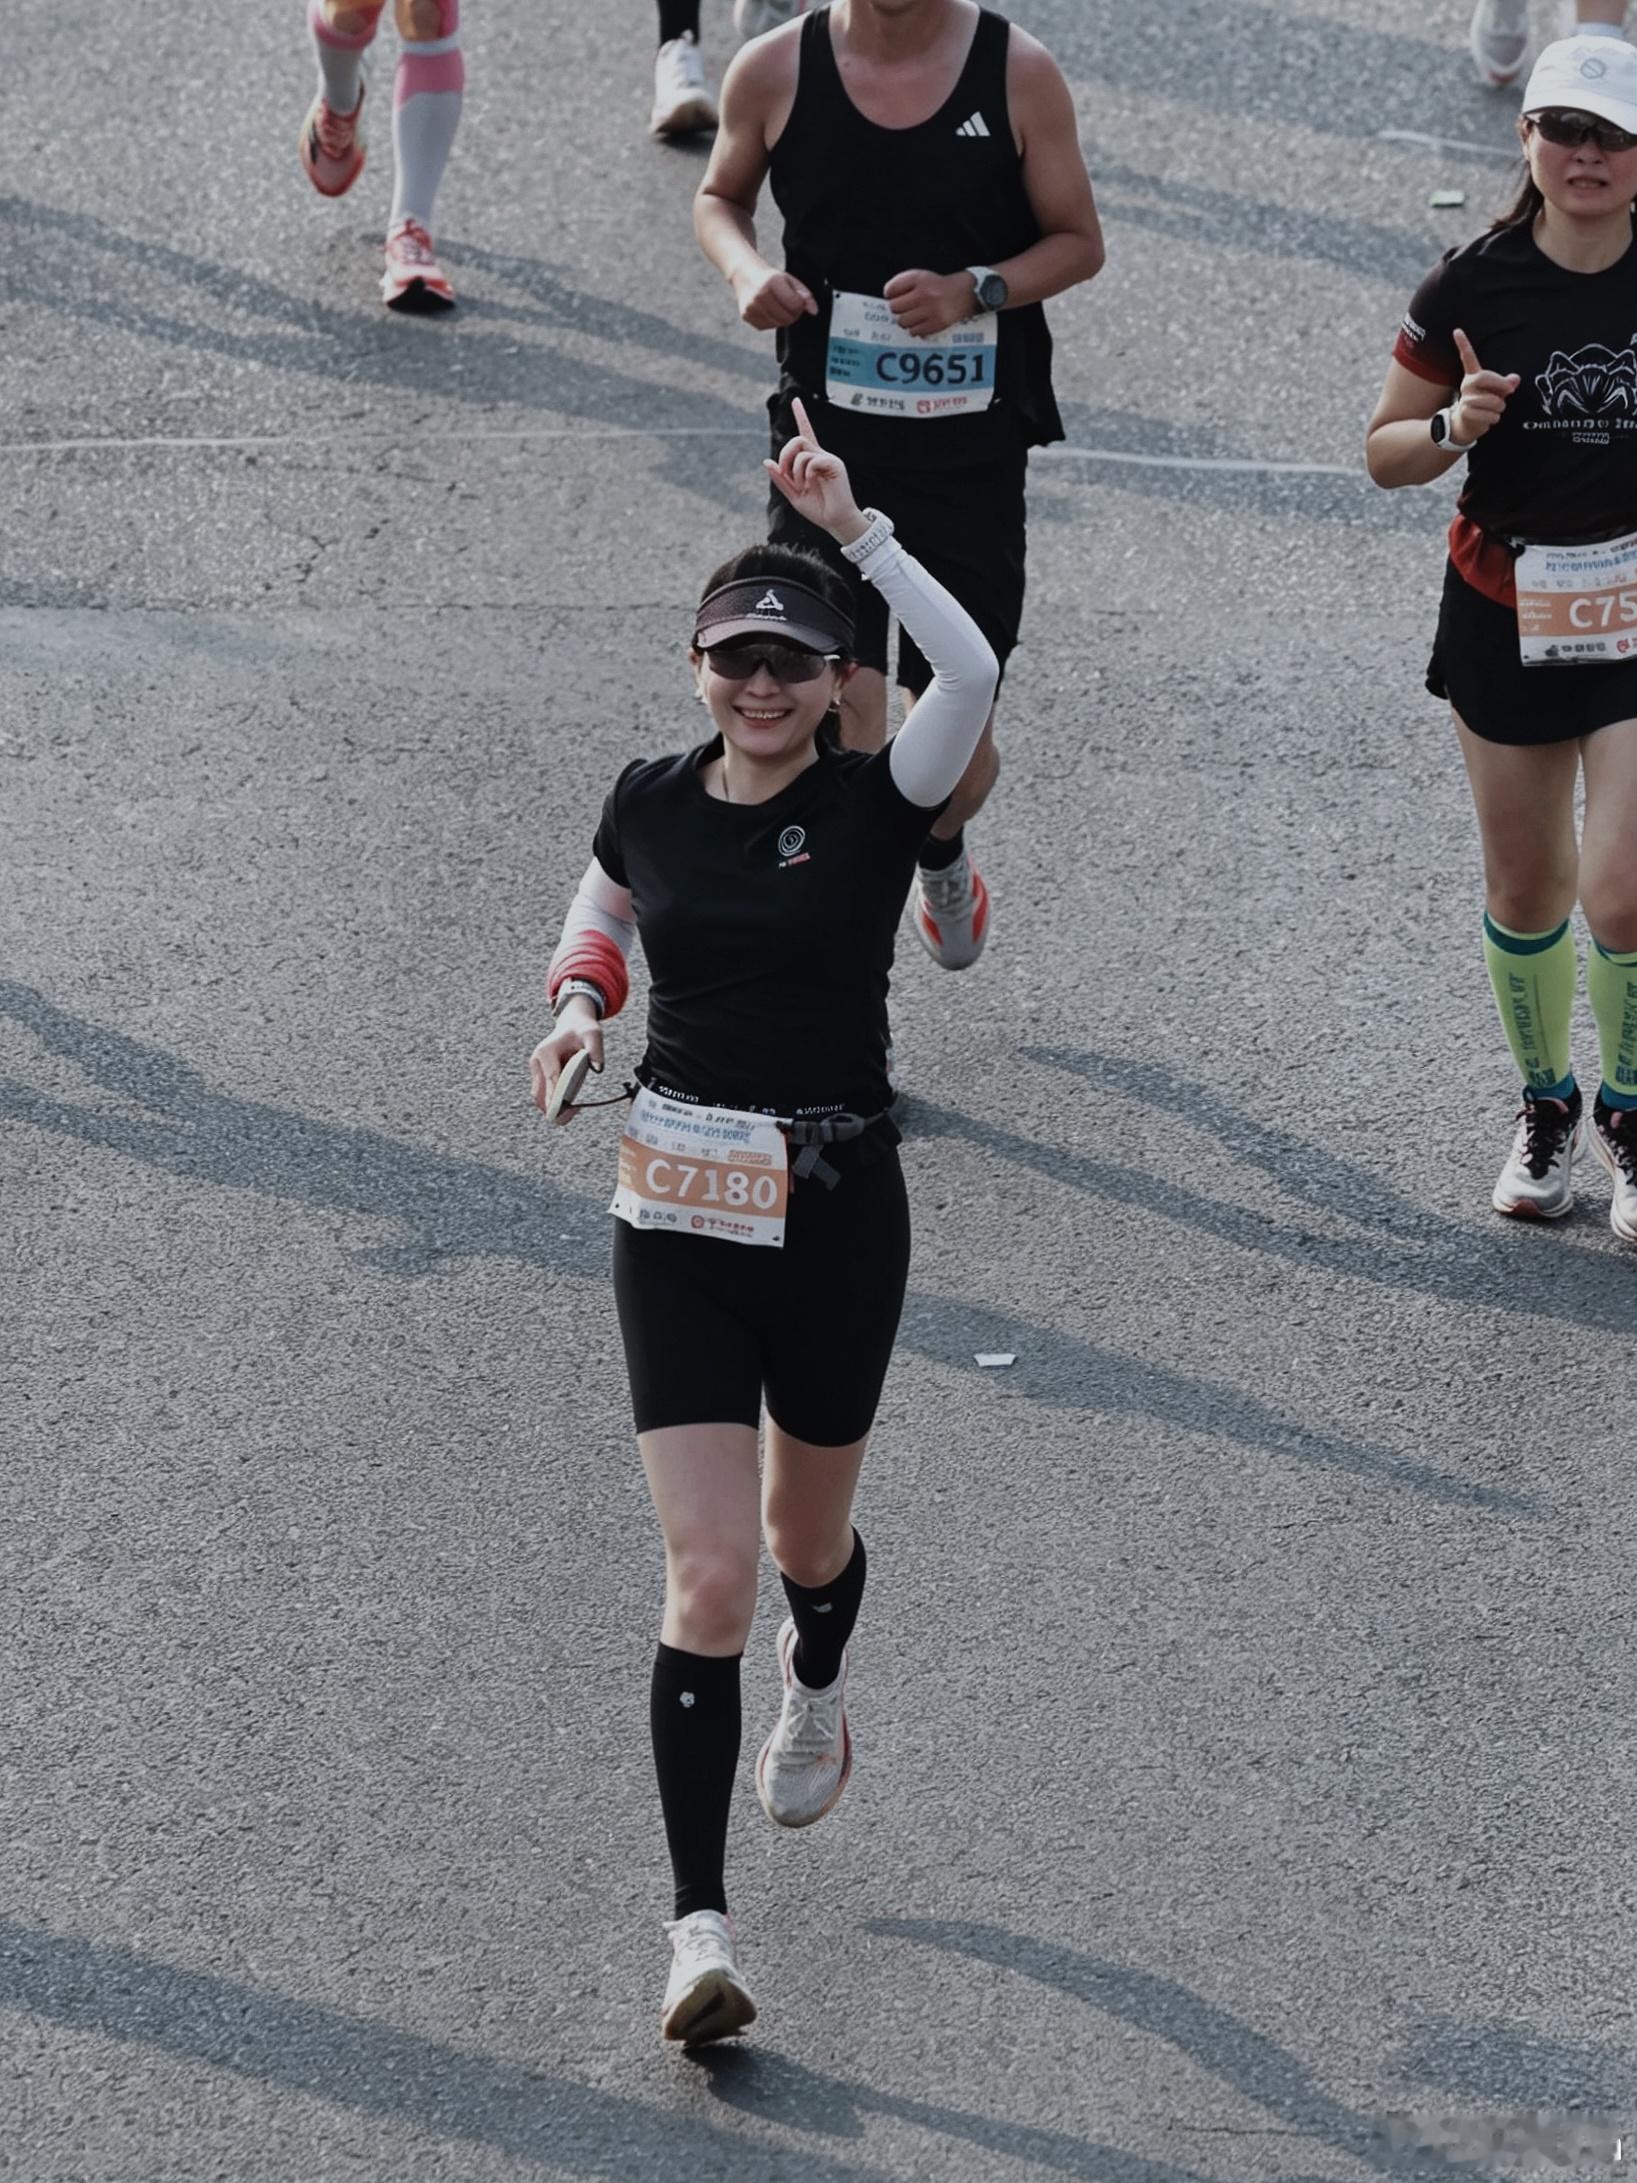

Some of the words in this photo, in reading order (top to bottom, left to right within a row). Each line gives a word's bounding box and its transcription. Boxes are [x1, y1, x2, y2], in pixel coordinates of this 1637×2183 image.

[876, 352, 985, 385] C9651
[1569, 591, 1637, 628] C75
[645, 1158, 778, 1210] C7180
